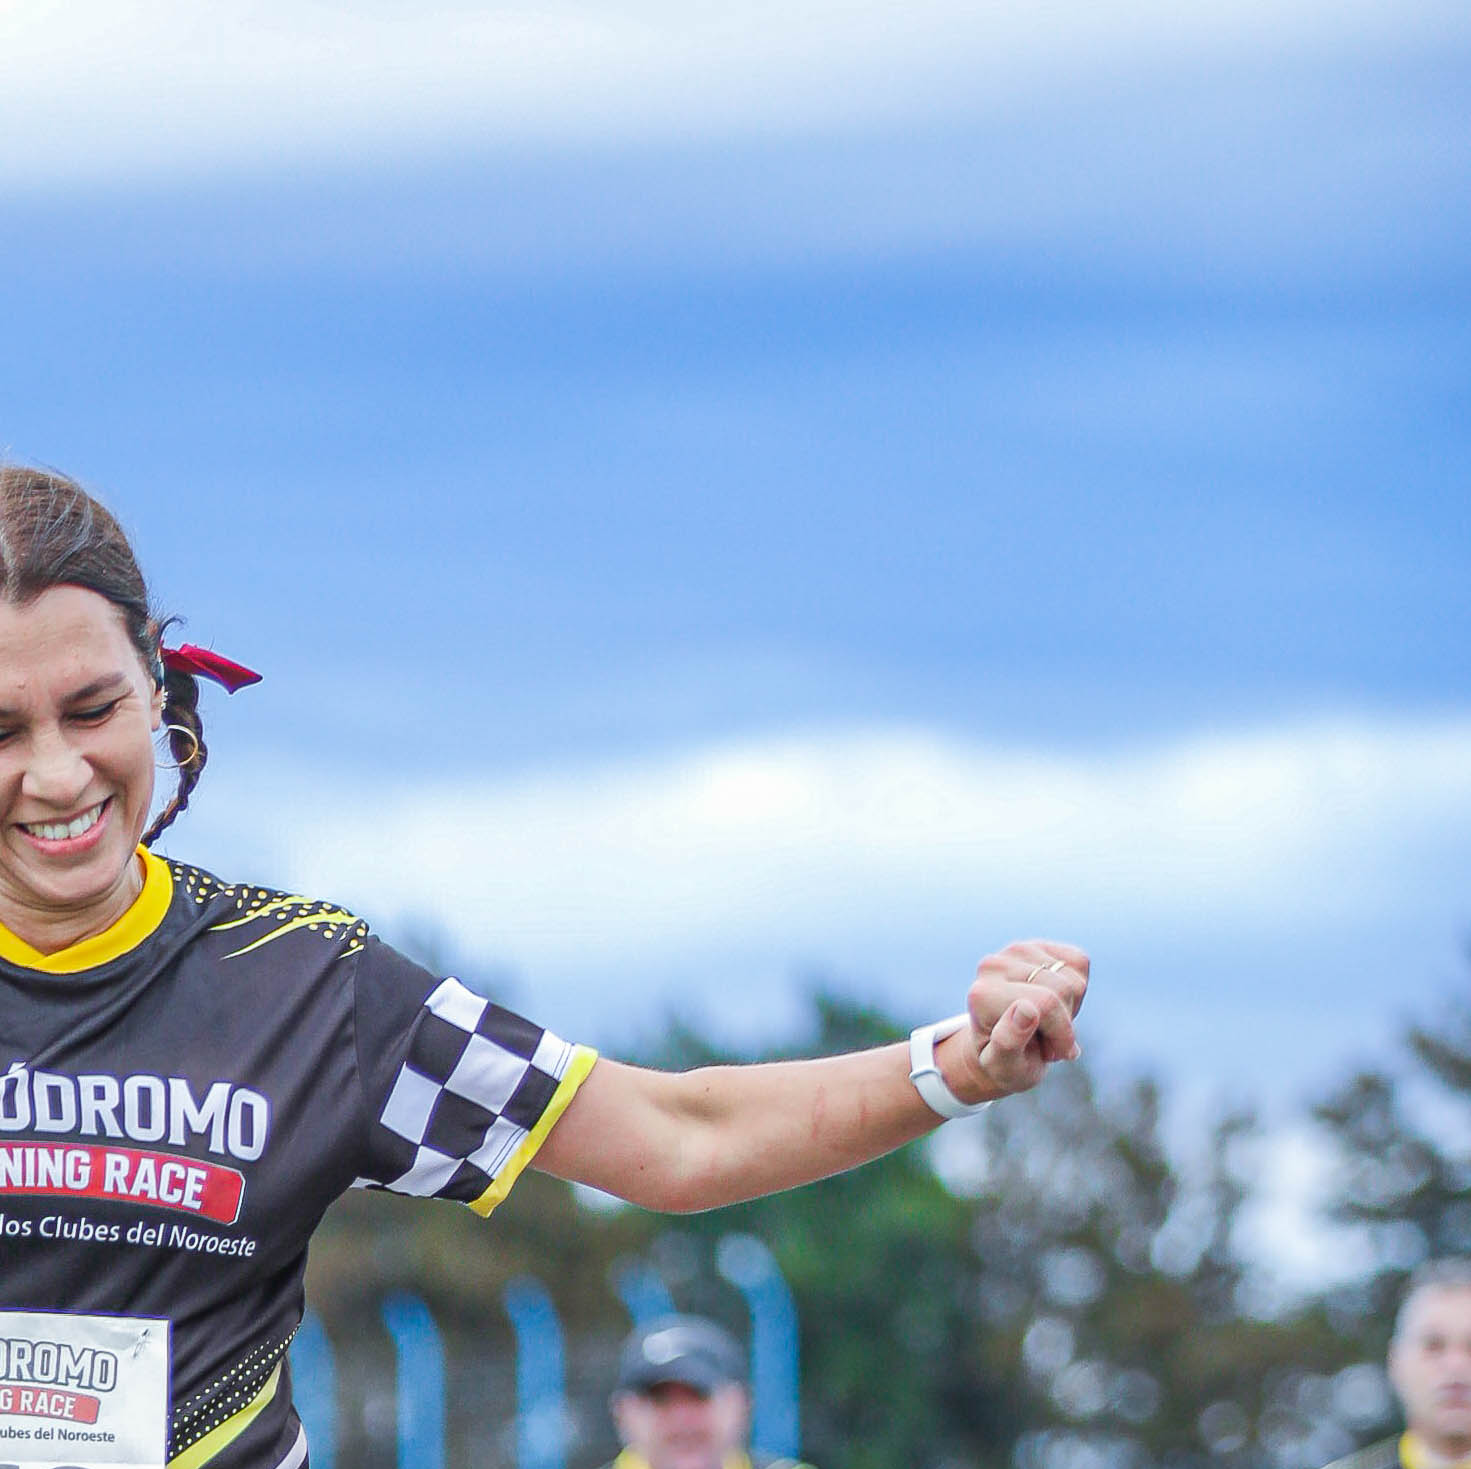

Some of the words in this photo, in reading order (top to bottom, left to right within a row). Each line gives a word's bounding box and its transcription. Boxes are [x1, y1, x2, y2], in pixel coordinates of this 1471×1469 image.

[103, 1153, 208, 1210] RACE
[39, 1215, 120, 1242] Clubes
[126, 1221, 165, 1247] del
[168, 1225, 256, 1257] Noroeste
[20, 1390, 77, 1419] RACE
[34, 1427, 54, 1440] del
[57, 1428, 116, 1442] Noroeste
